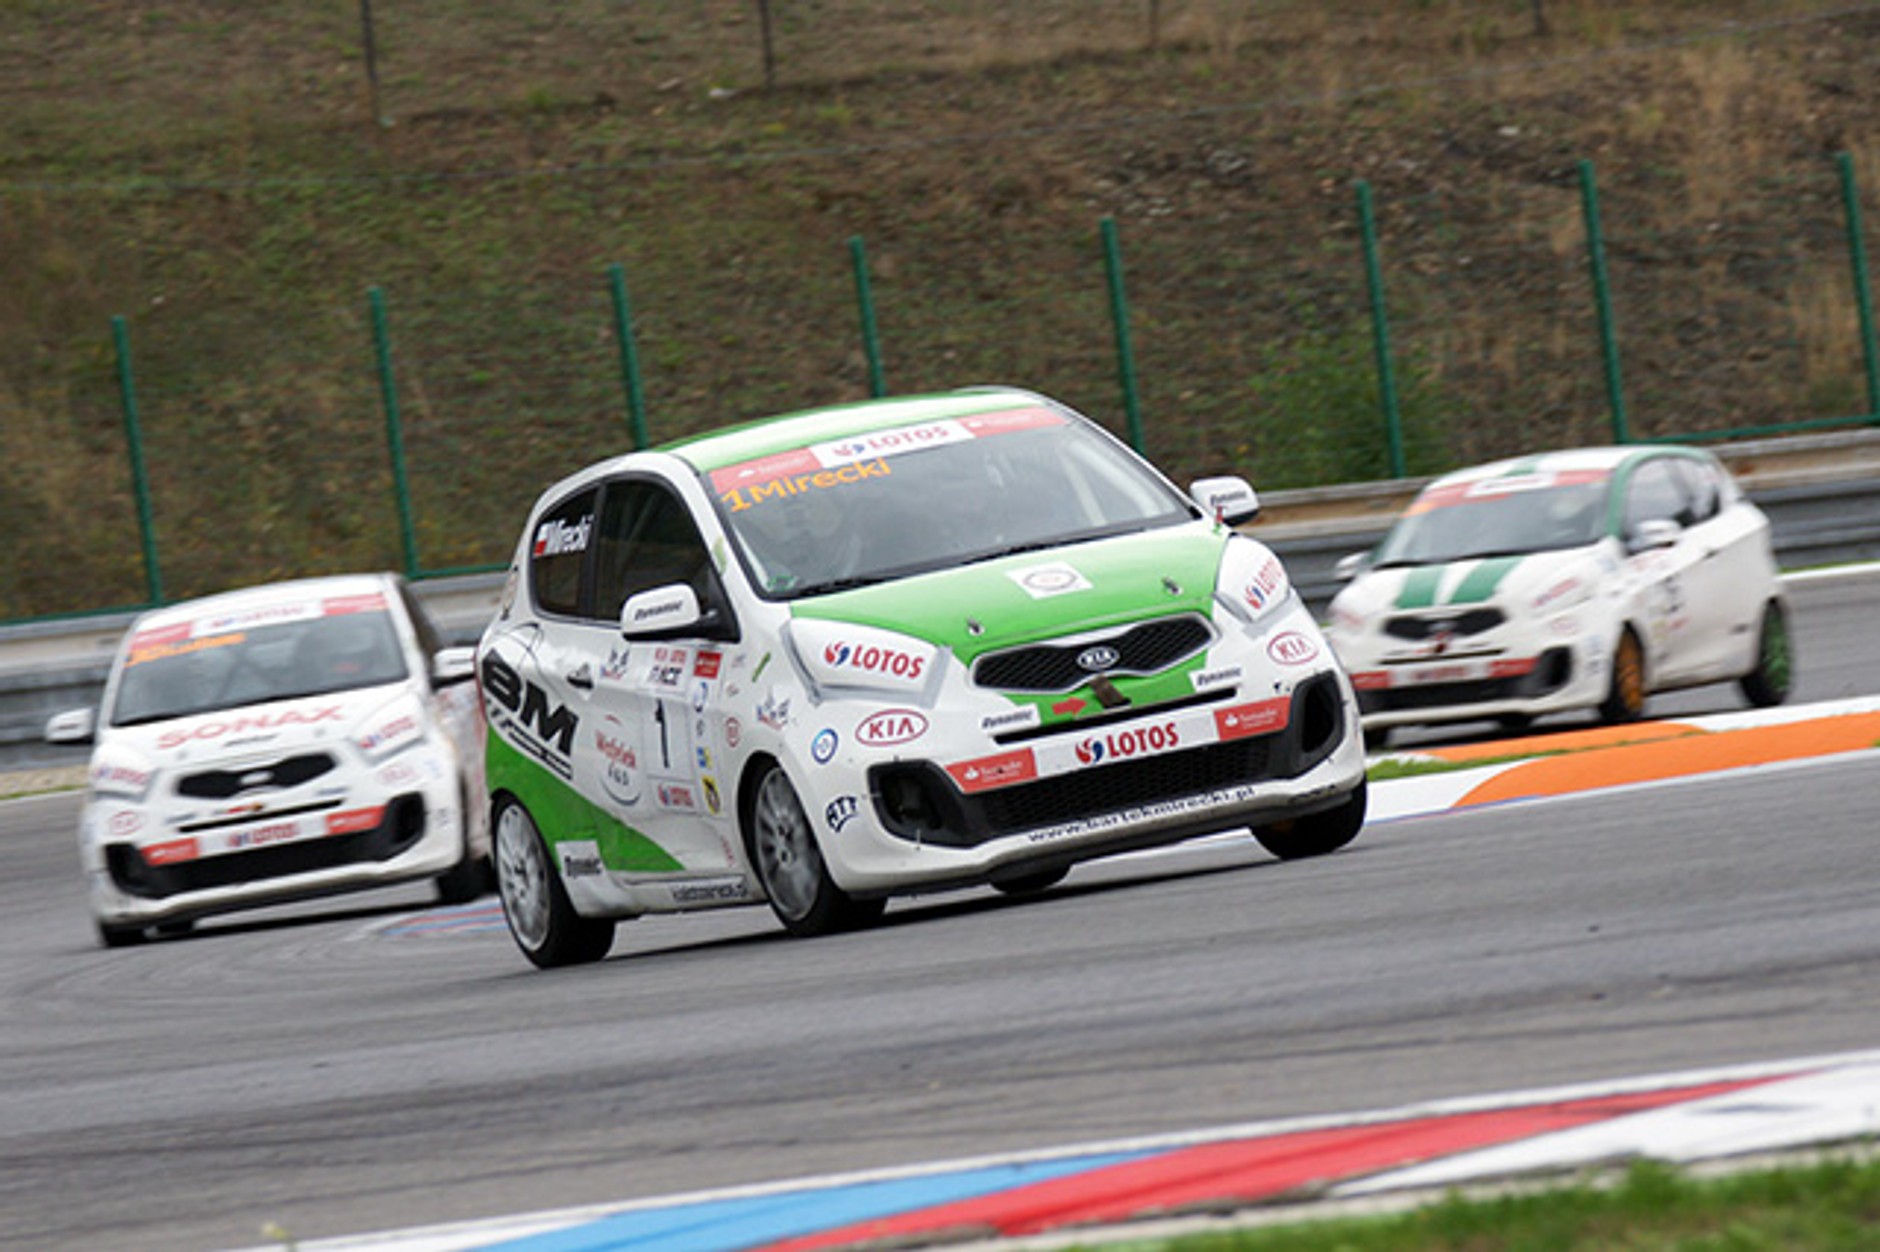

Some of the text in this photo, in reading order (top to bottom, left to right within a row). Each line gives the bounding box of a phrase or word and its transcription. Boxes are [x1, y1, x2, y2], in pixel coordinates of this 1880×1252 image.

[868, 423, 950, 453] LOTOS
[851, 642, 925, 680] LOTOS
[1275, 640, 1313, 660] KIA
[481, 647, 579, 758] BM
[156, 704, 346, 749] SONAX
[655, 697, 670, 770] 1
[868, 715, 916, 740] KIA
[1105, 722, 1180, 758] LOTOS
